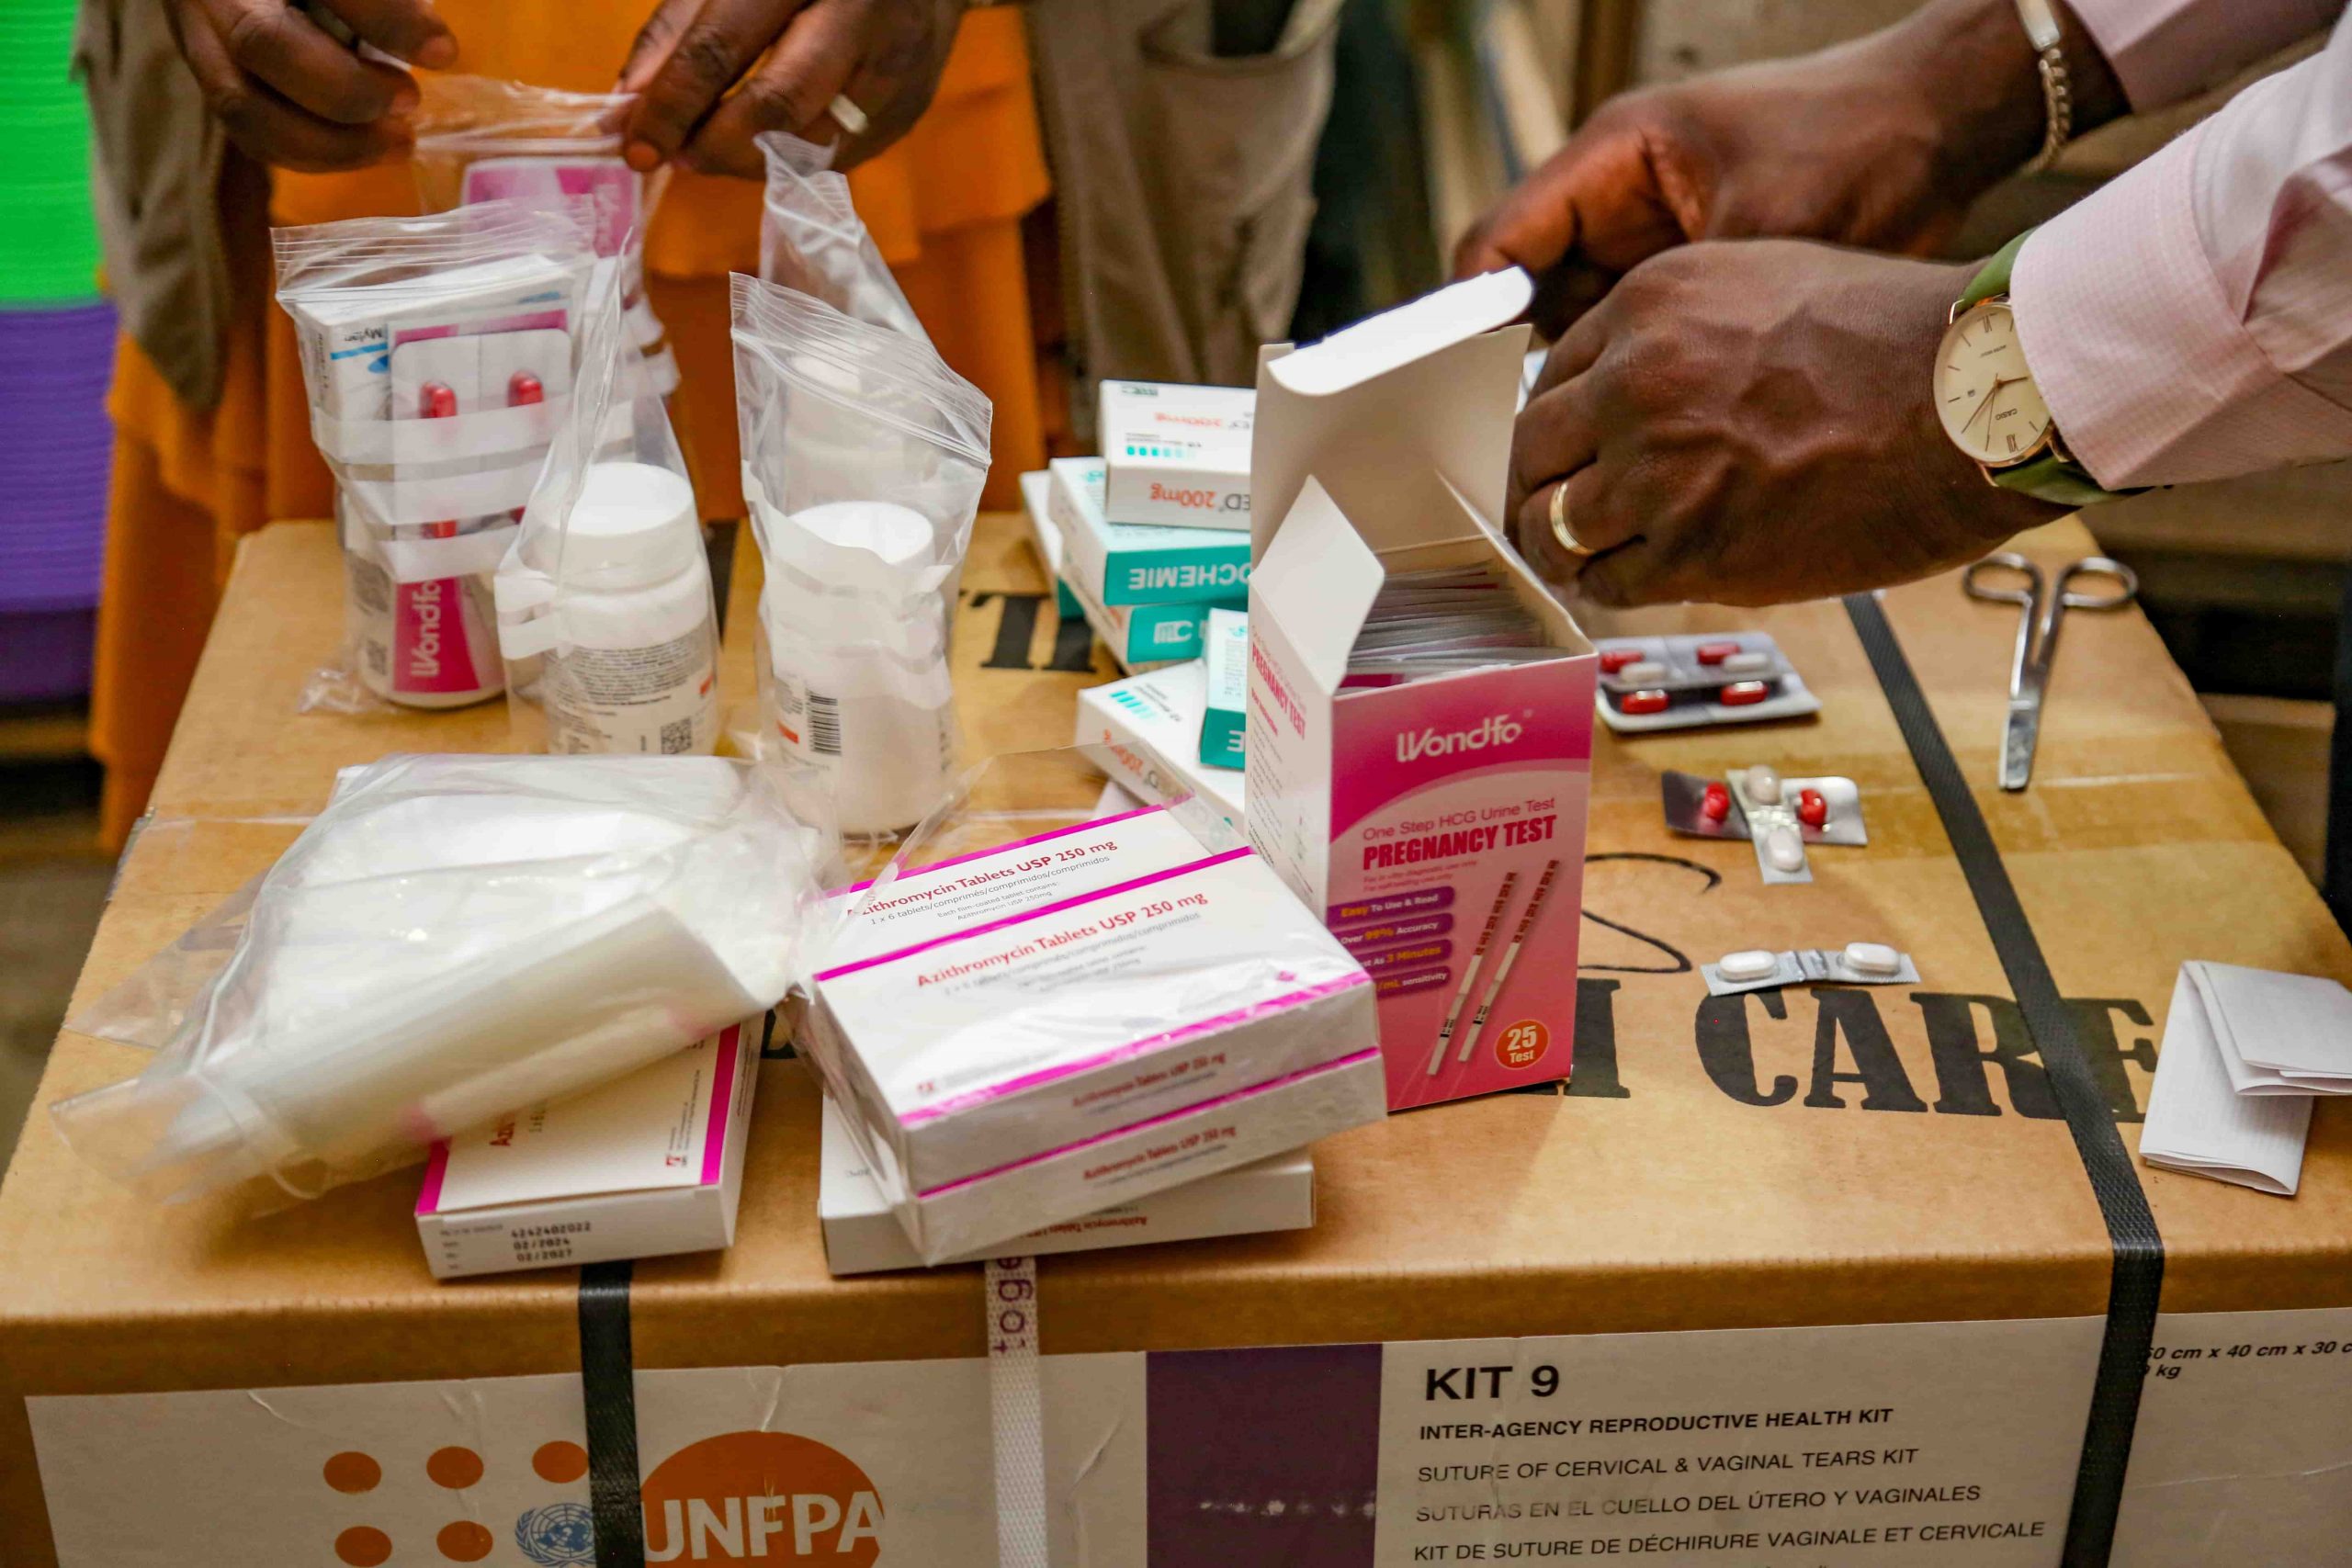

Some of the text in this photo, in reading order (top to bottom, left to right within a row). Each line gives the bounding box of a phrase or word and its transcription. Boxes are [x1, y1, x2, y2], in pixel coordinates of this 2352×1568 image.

[1150, 482, 1216, 508] 200mg
[1396, 714, 1523, 763] Wondfo
[1363, 796, 1555, 840] One Step HCG Urine Test
[1363, 814, 1557, 871] PREGNANCY TEST
[956, 866, 1015, 890] Tablets
[1016, 856, 1052, 874] USP
[1056, 848, 1086, 863] 250
[1089, 840, 1118, 855] mg
[1341, 907, 1368, 918] Easy
[1371, 904, 1383, 913] To
[1385, 901, 1403, 910] Use
[1414, 894, 1439, 905] Read
[916, 944, 1036, 987] Azithromycin
[1036, 926, 1098, 950] Tablets
[1099, 910, 1137, 931] USP
[1141, 900, 1174, 919] 250
[1177, 892, 1209, 908] mg
[1341, 934, 1363, 945] Over
[1396, 921, 1440, 935] Accuracy
[1386, 953, 1394, 963] 3
[1397, 946, 1442, 961] Minutes
[1507, 1024, 1538, 1064] 25 Test
[1695, 981, 2158, 1123] CARE
[2171, 1347, 2202, 1359] cm
[2208, 1347, 2222, 1359] x
[2226, 1344, 2252, 1358] 40
[2256, 1345, 2288, 1358] cm
[2292, 1344, 2307, 1356] x
[2312, 1341, 2337, 1355] 30
[1425, 1364, 1560, 1402] KIT 9
[2156, 1364, 2182, 1380] kg
[1419, 1408, 1894, 1441] INTER-AGENCY REPRODUCTIVE HEALTH KIT
[1418, 1449, 1920, 1483] SUTURE OF CERVICAL & VAGINAL TEARS KIT
[1416, 1484, 1981, 1522] SUTURAS EN EL CUELLO DEL ÚTERO Y VAGINALES
[642, 1490, 885, 1562] UNFPA
[1414, 1521, 2046, 1562] KIT DE SUTURE DE DÉCHIRURE VAGINALE ET CERVICALE
